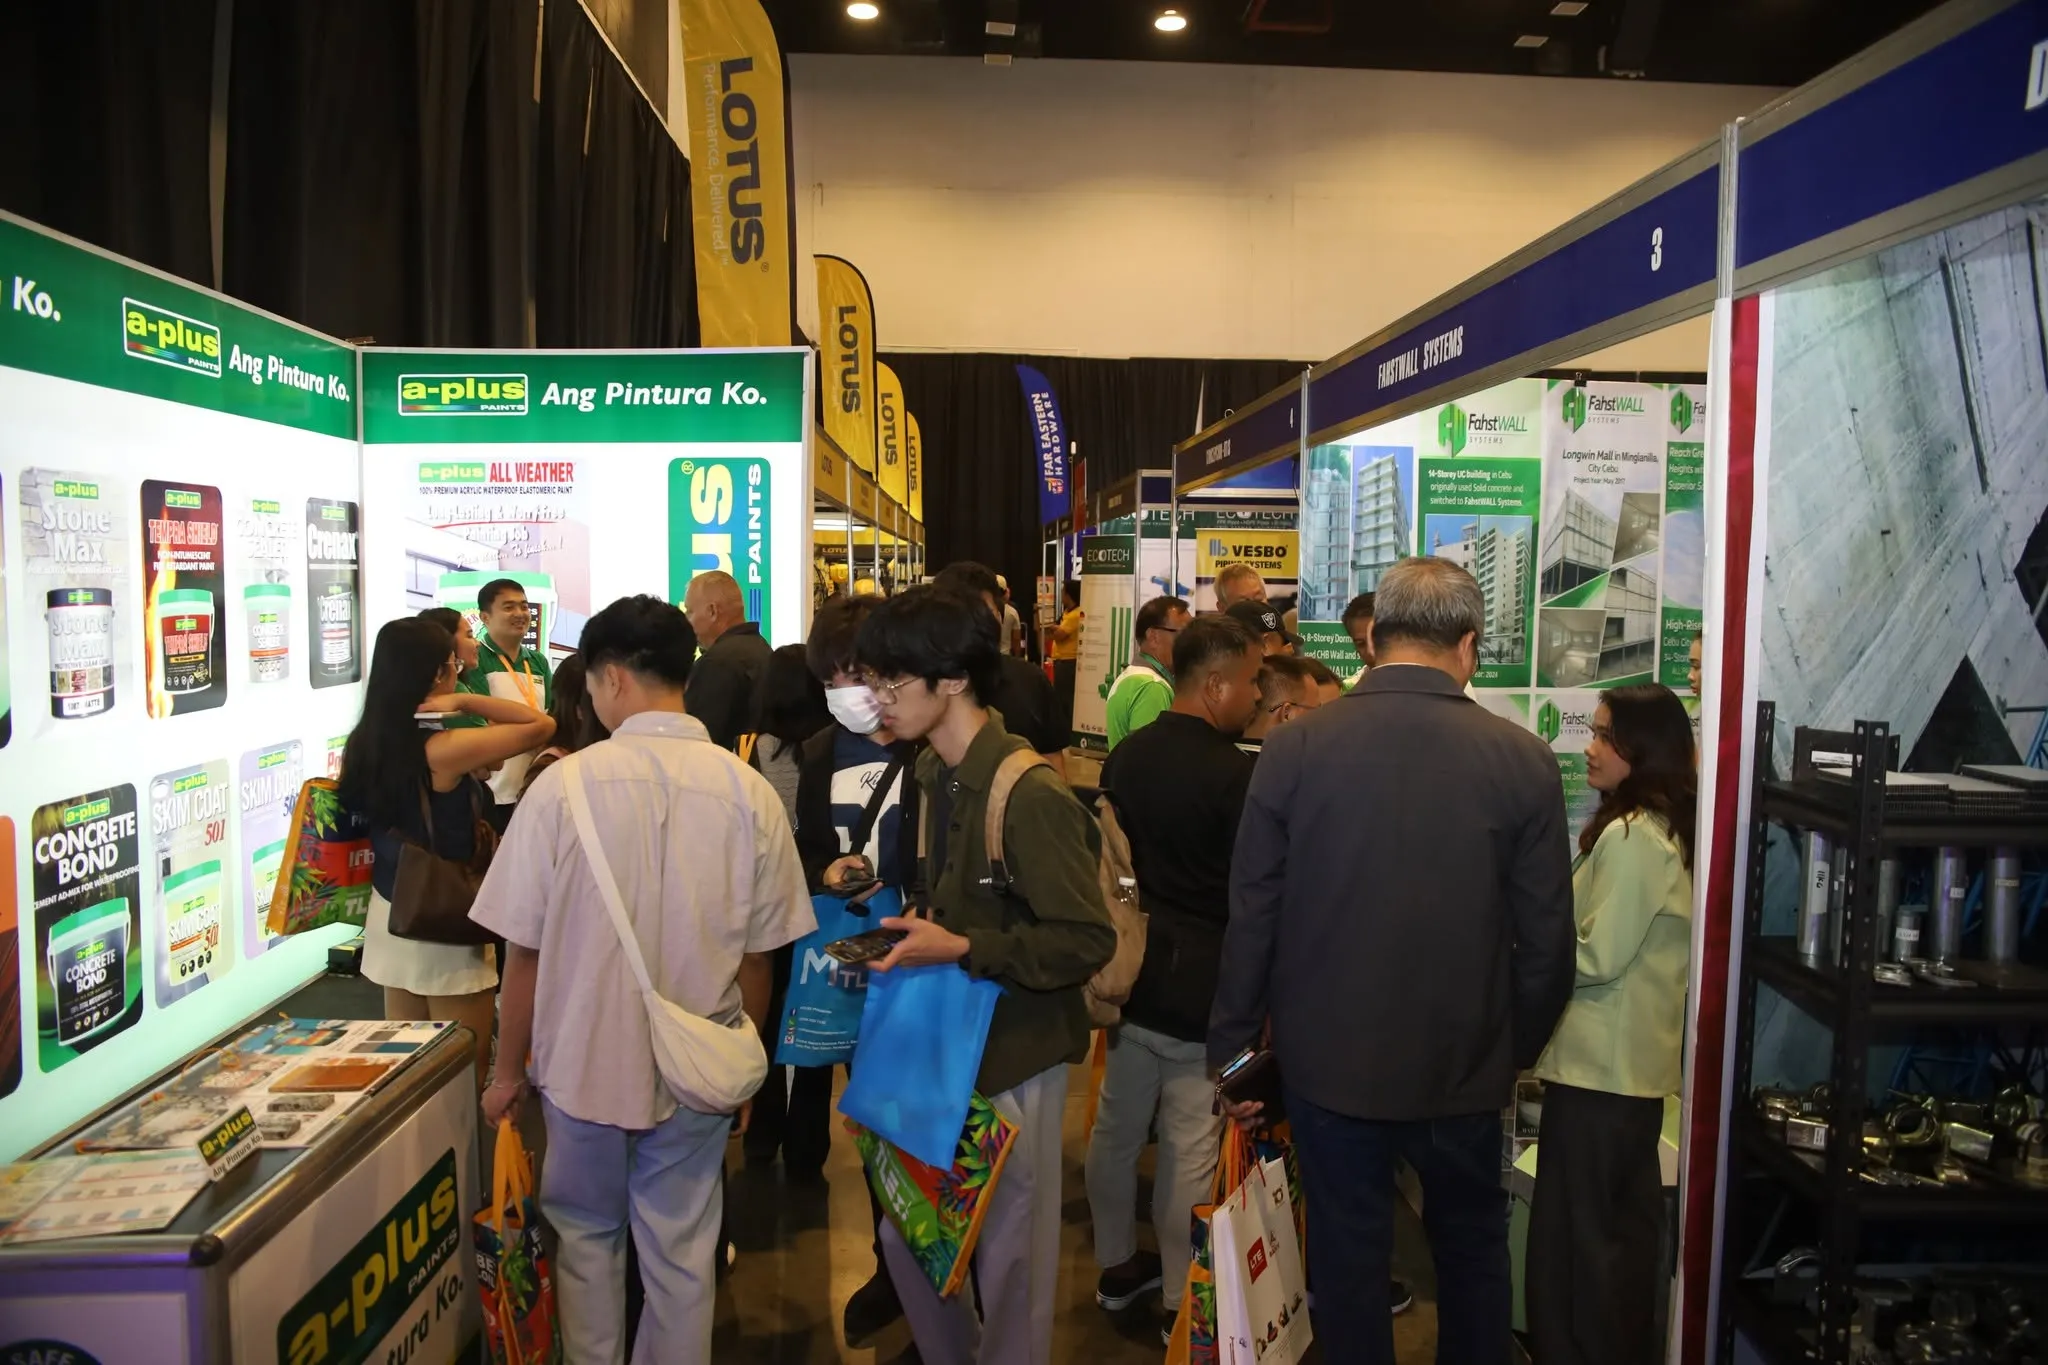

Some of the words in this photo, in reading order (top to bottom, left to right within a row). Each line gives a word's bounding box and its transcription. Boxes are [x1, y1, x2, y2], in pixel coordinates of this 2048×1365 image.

[720, 56, 765, 264] LOTUS
[1650, 227, 1663, 272] 3
[13, 275, 61, 322] Ko.
[126, 309, 219, 358] a-plus
[1423, 325, 1464, 371] SYSTEMS
[187, 356, 219, 371] PAINTS
[229, 344, 263, 385] Ang
[267, 354, 324, 395] Pintura
[328, 375, 350, 402] Ko.
[838, 305, 861, 414] LOTUS
[402, 377, 525, 405] a-plus
[540, 382, 597, 413] Ang
[605, 382, 712, 406] Pintura
[721, 381, 768, 406] Ko.
[880, 392, 898, 466] LOTUS
[1031, 392, 1052, 450] EASTERN
[1041, 391, 1064, 476] HARDWARE
[420, 464, 484, 481] a-plus
[489, 462, 513, 483] ALL
[515, 462, 575, 483] WEATHER
[1043, 452, 1054, 476] FAR
[1562, 449, 1596, 463] Longwin
[1597, 449, 1613, 461] Mall
[42, 501, 111, 533] Stone
[148, 519, 187, 544] TEMPRA
[187, 521, 218, 546] SHIELD
[748, 463, 762, 584] PAINTS
[53, 533, 104, 563] Max
[1087, 548, 1130, 563] ECOTECH
[1232, 544, 1288, 558] VESBO
[66, 801, 109, 823] a-plus
[152, 794, 192, 835] SKIM
[193, 782, 229, 822] COAT
[35, 810, 136, 865] CONCRETE
[205, 818, 226, 847] 501
[58, 842, 119, 886] BOND
[65, 948, 116, 984] CONCRETE
[75, 967, 107, 994] BOND
[201, 1111, 252, 1158] a-plus
[288, 1176, 457, 1365] a-plus
[408, 1228, 458, 1296] PAINTS
[436, 1274, 464, 1322] Ko.
